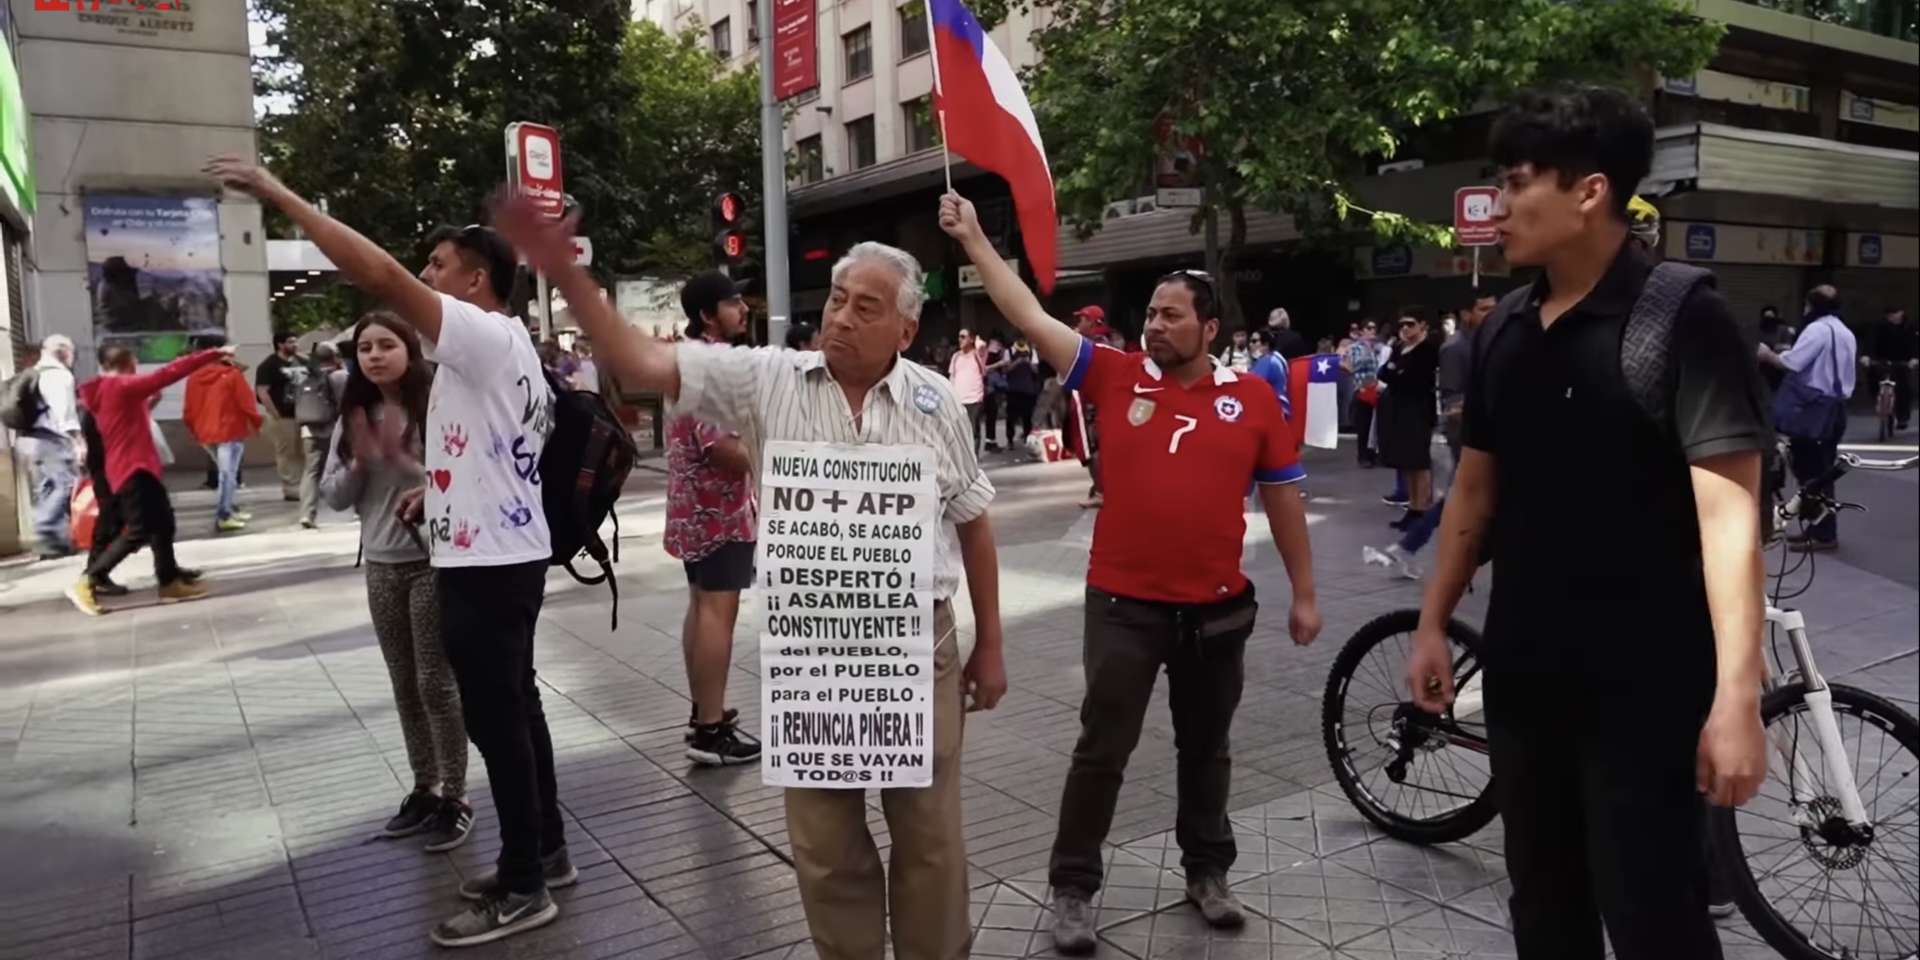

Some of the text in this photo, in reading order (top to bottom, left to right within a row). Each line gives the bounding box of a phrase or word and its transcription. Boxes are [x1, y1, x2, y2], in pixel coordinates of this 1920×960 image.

[1168, 414, 1198, 453] 7
[772, 456, 921, 482] NUEVA CONSTITUCIÓN
[773, 487, 916, 515] NO + AFP
[768, 519, 922, 541] SE ACABÓ, SE ACABÓ
[766, 544, 912, 563] PORQUE EL PUEBLO
[780, 567, 903, 589] DESPERTÓ
[909, 572, 916, 588] !
[788, 592, 919, 609] ASAMBLEA
[768, 615, 921, 639] CONSTITUYENTE !!
[780, 646, 909, 658] del PUEBLO,
[770, 664, 920, 679] por el PUEBLO
[771, 689, 811, 703] para
[816, 688, 832, 701] el
[838, 688, 914, 702] PUEBLO
[783, 711, 856, 746] RENUNCIA
[915, 713, 924, 746] !!
[786, 752, 825, 766] QUE
[830, 753, 854, 767] SE
[859, 754, 924, 767] VAYAN
[793, 769, 894, 783] TOD@S !!
